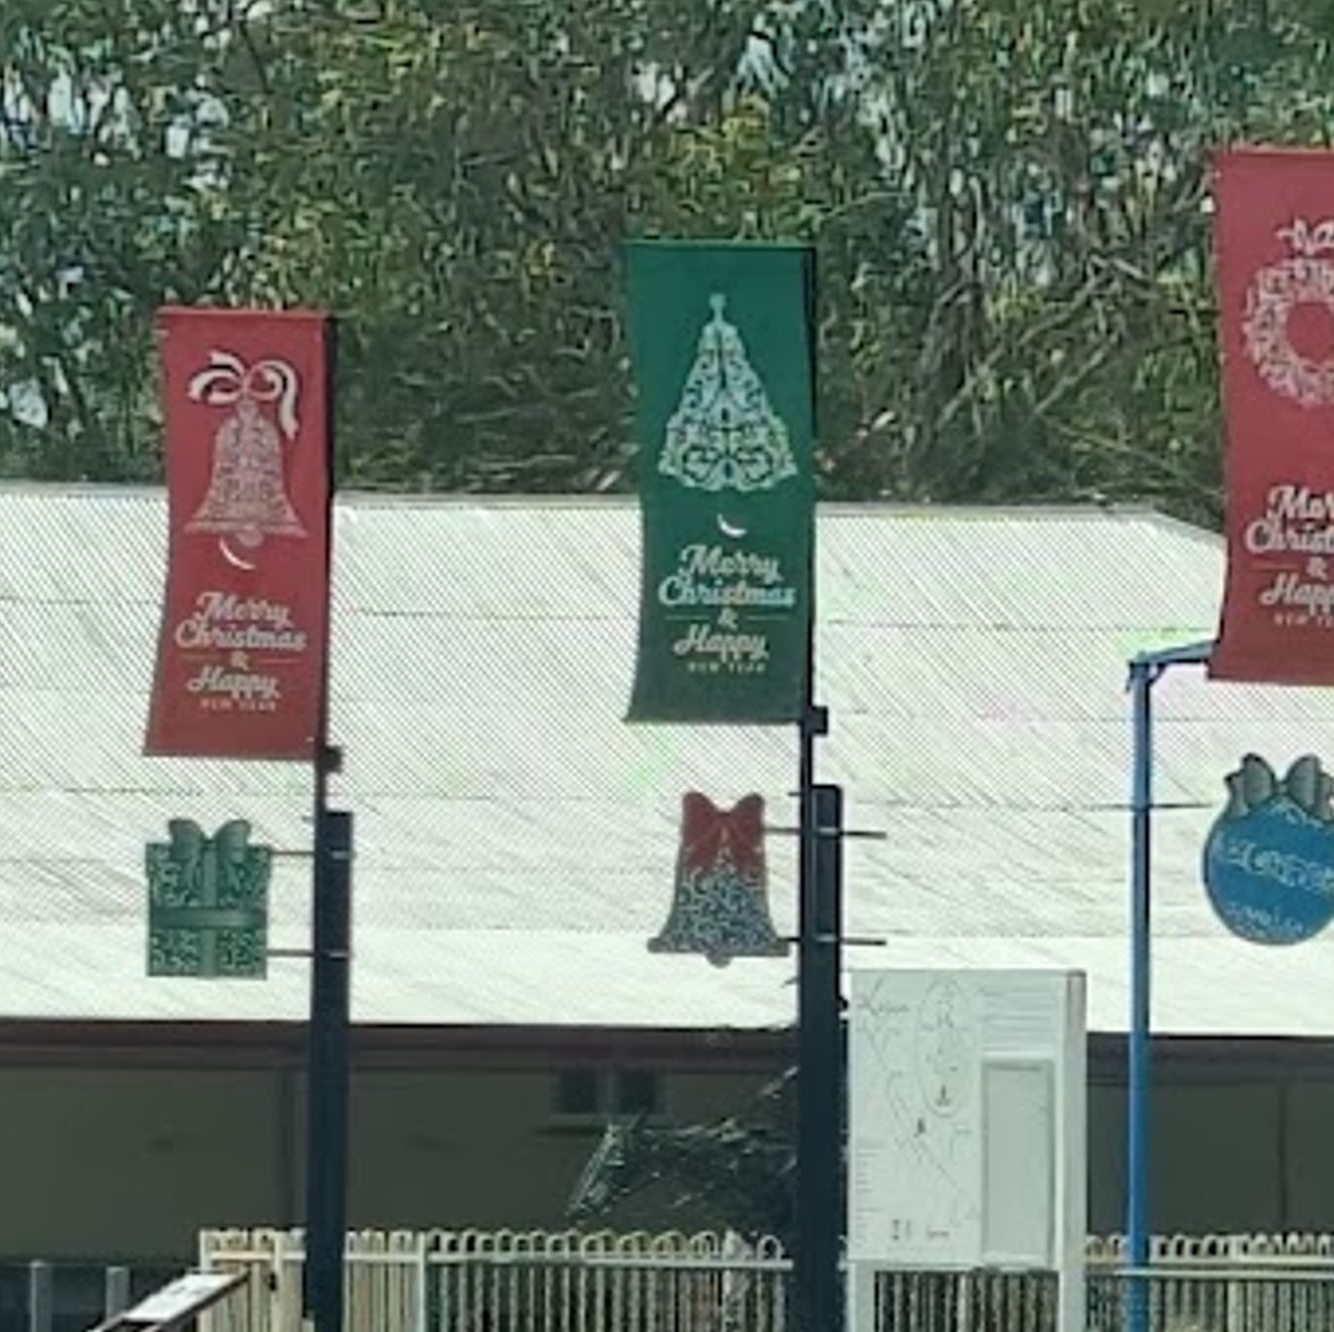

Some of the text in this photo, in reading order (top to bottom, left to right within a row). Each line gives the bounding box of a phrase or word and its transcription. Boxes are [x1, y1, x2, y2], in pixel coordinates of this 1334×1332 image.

[678, 543, 784, 585] Merry
[657, 573, 797, 608] Christmas
[192, 590, 295, 630] Merry
[173, 616, 308, 652] Christmas
[673, 623, 770, 663] Happy
[186, 666, 283, 700] Happy
